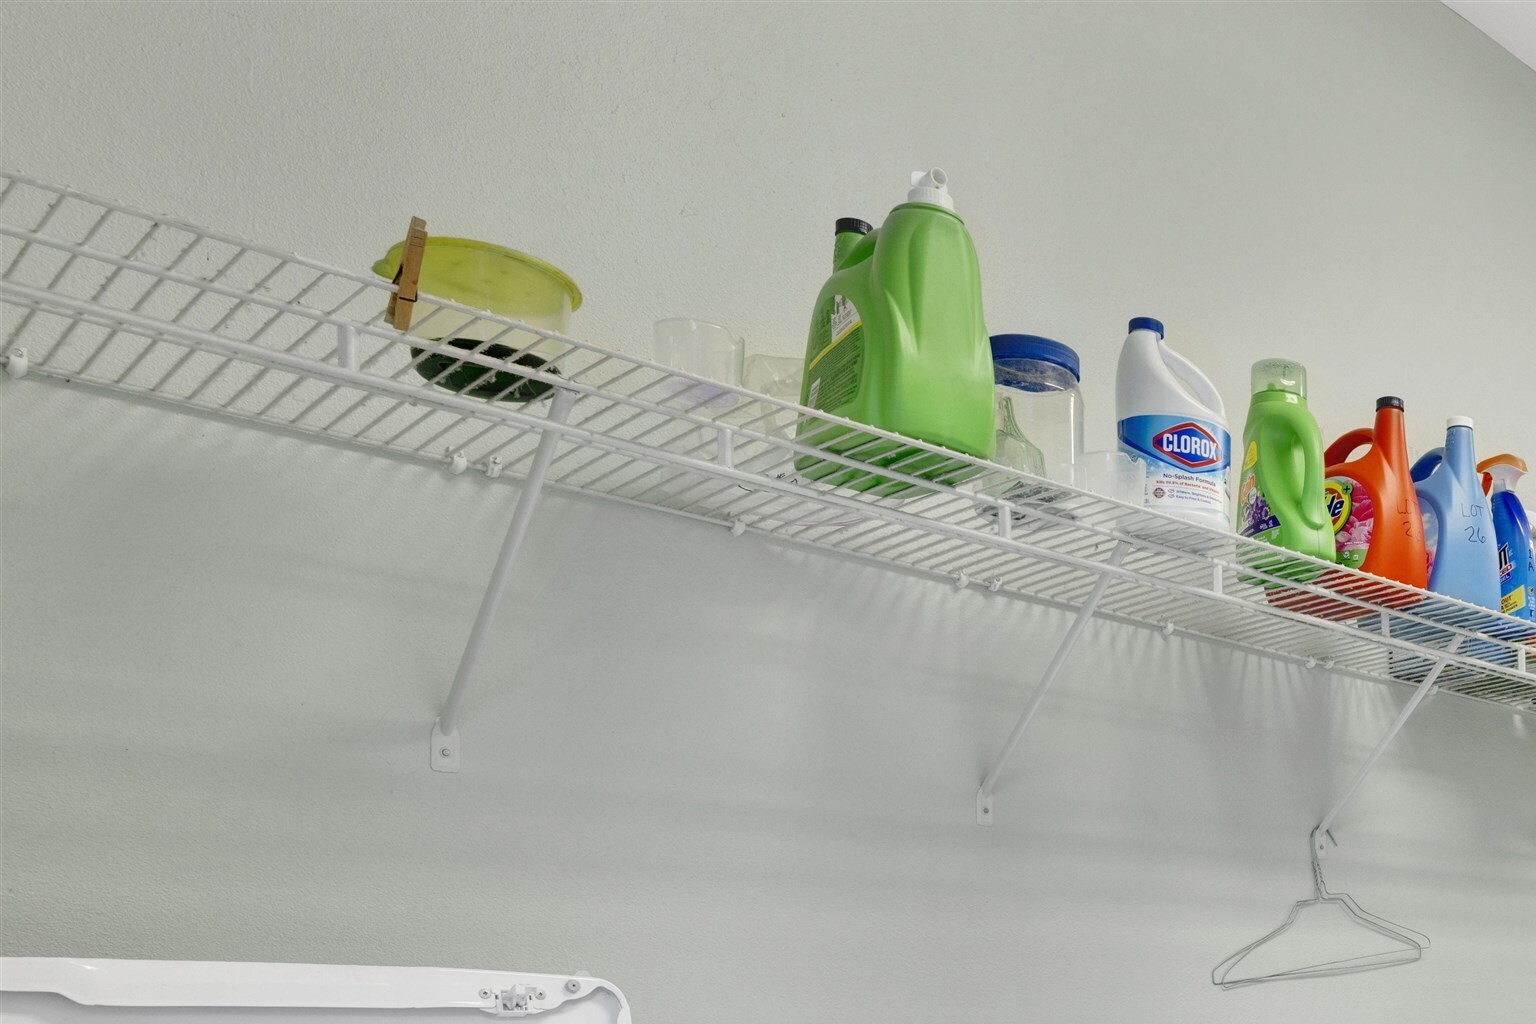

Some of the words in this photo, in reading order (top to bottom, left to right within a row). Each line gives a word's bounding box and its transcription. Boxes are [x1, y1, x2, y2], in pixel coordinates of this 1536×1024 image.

[1162, 434, 1218, 460] CLOROX
[1461, 503, 1484, 518] LOT
[1464, 526, 1486, 544] 26
